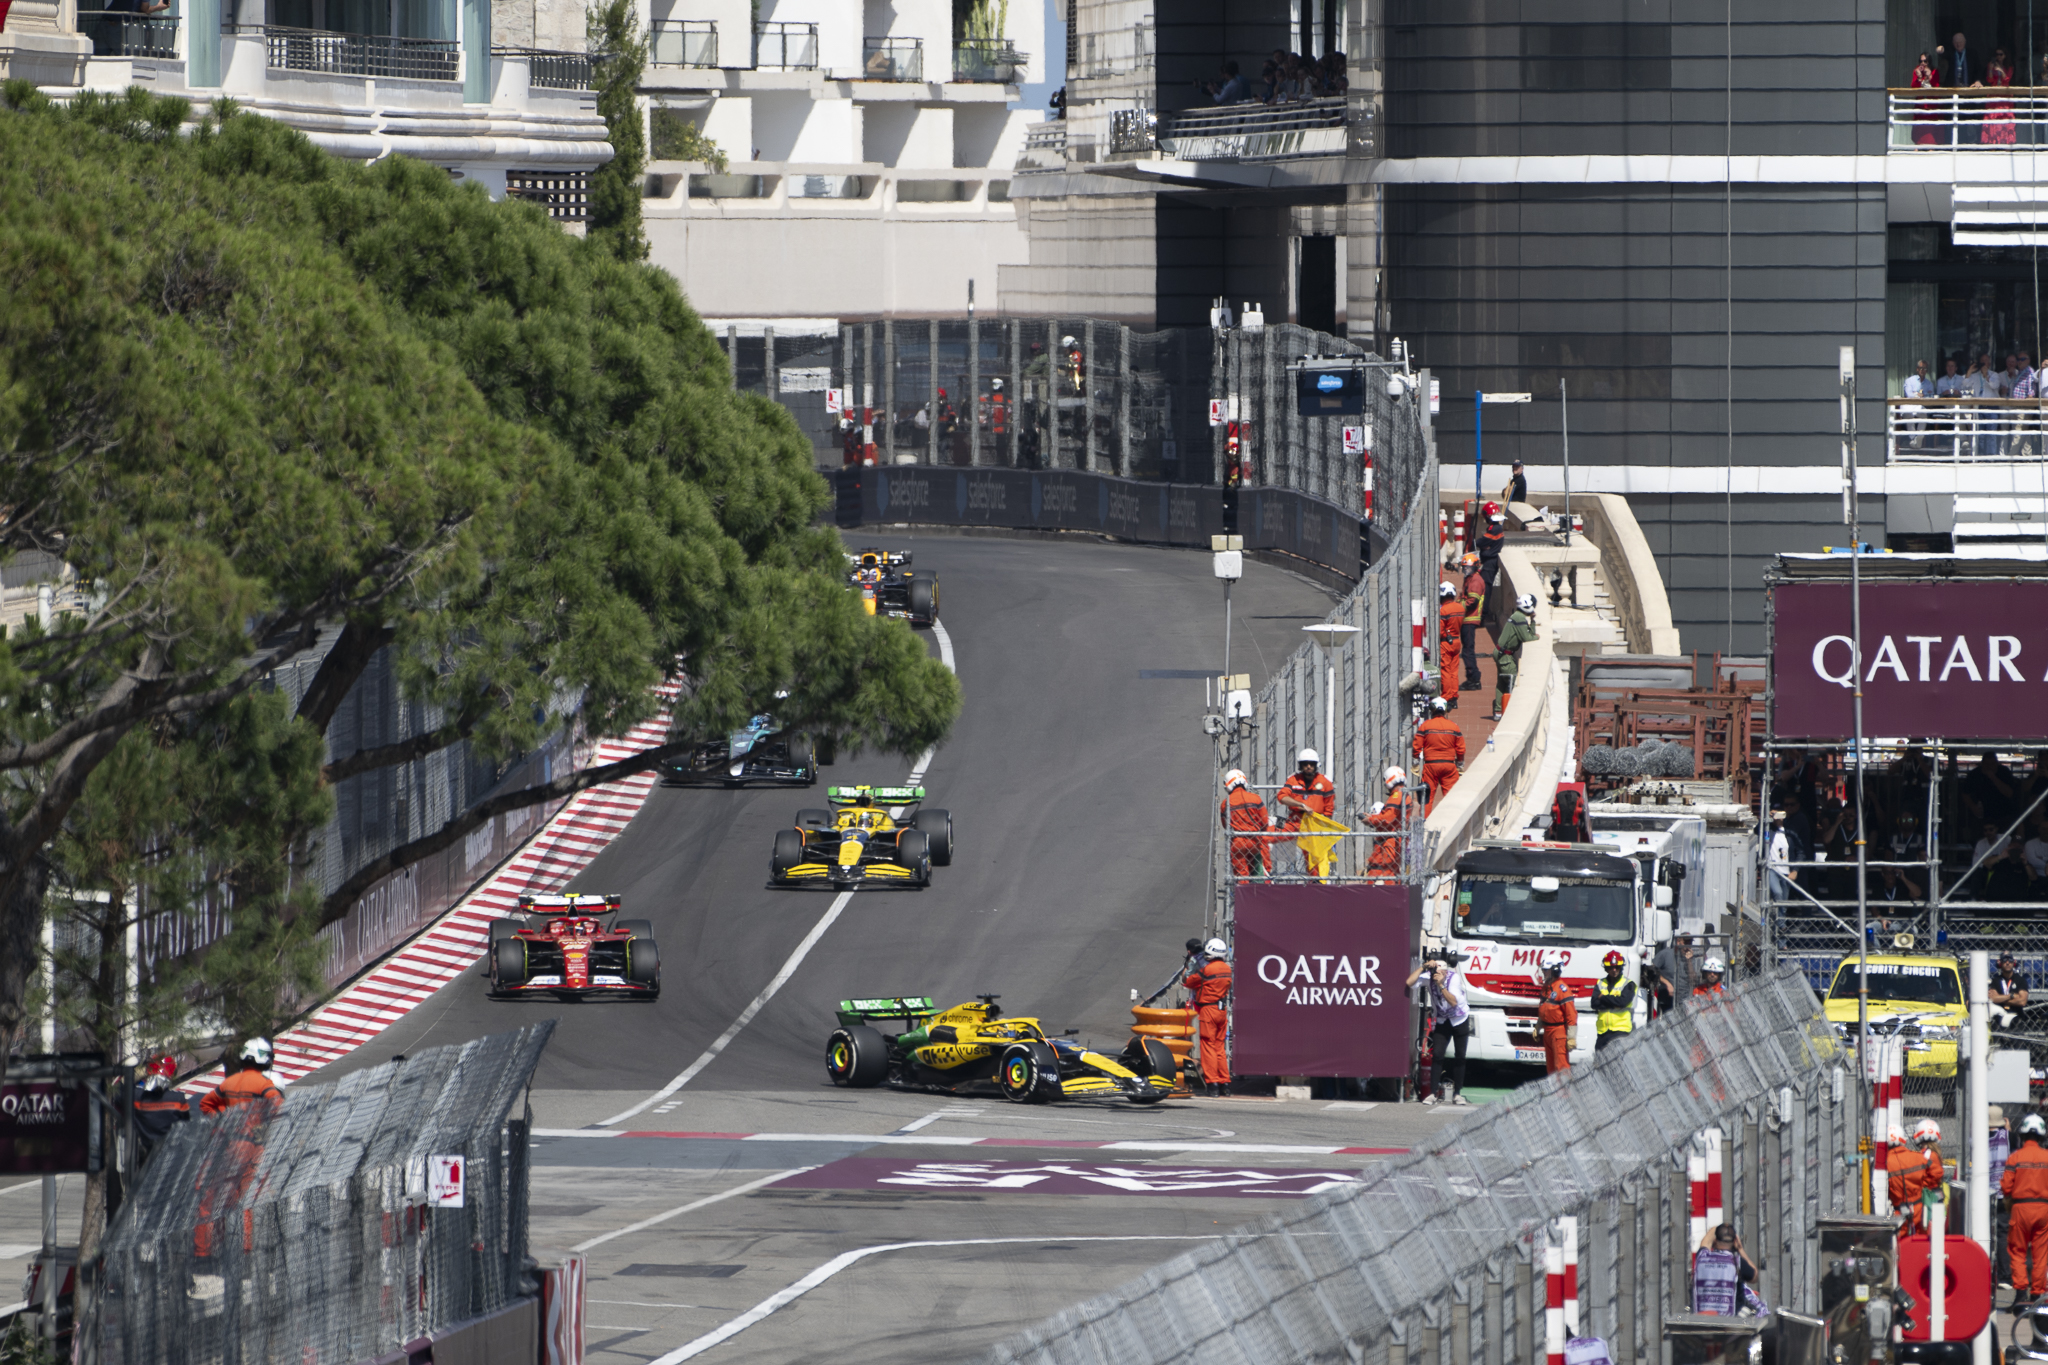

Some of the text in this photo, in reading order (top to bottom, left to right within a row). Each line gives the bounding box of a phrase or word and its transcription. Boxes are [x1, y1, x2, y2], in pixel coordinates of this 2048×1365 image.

[1812, 634, 2026, 688] QATAR
[357, 886, 385, 966] QATAR
[1257, 954, 1382, 990] QATAR
[1469, 955, 1492, 971] A7
[1853, 964, 1941, 978] SCURITE CIRCUIT
[1286, 986, 1383, 1006] AIRWAYS
[948, 1013, 974, 1024] chrome
[922, 1046, 957, 1065] OKX
[2, 1093, 64, 1117] QATAR
[16, 1112, 65, 1125] AIRWAYS
